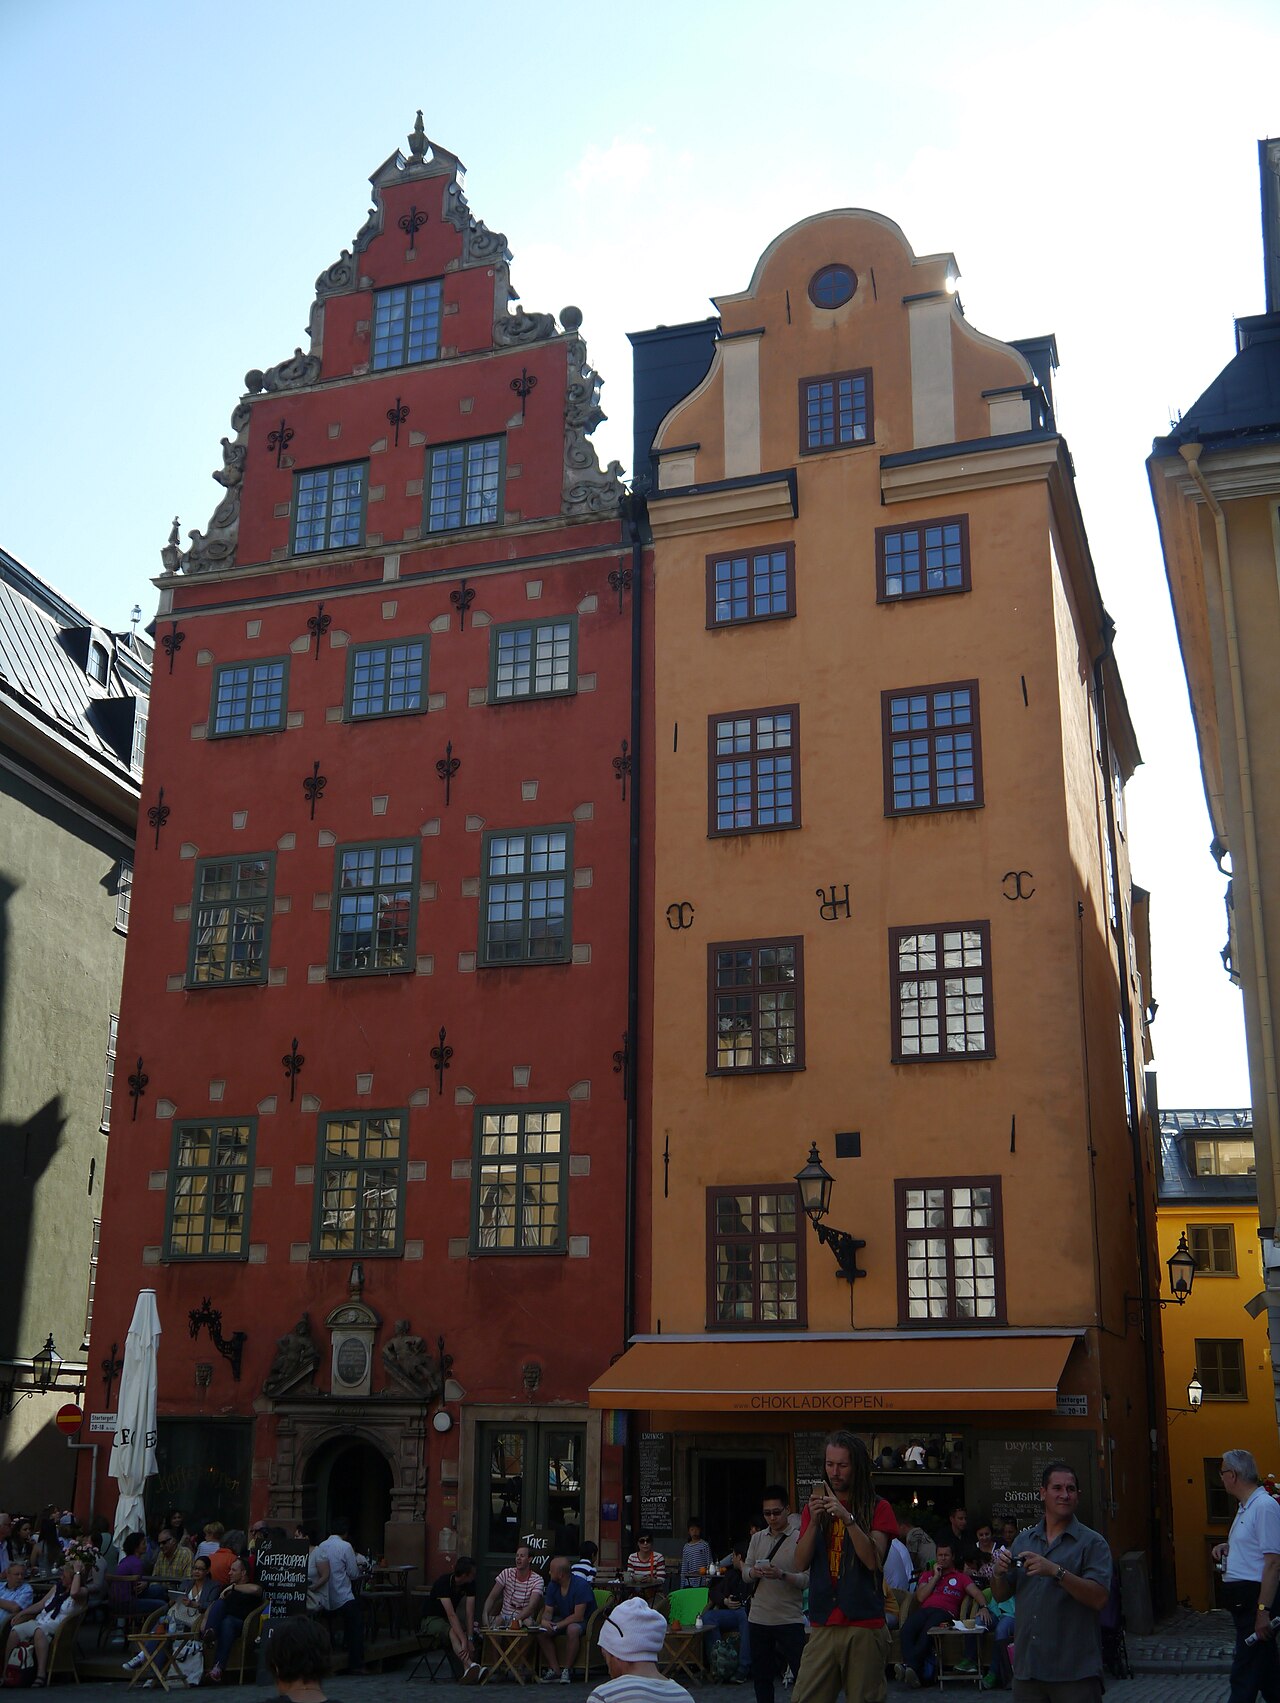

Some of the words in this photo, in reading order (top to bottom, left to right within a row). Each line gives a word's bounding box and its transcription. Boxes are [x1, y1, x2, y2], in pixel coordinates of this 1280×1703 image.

[92, 1414, 114, 1422] Stortorget
[1004, 1441, 1054, 1452] DRYCKER
[1004, 1490, 1043, 1502] SÖTSAK
[521, 1533, 549, 1549] TAKE
[256, 1549, 309, 1568] KAFFEKOPPEN
